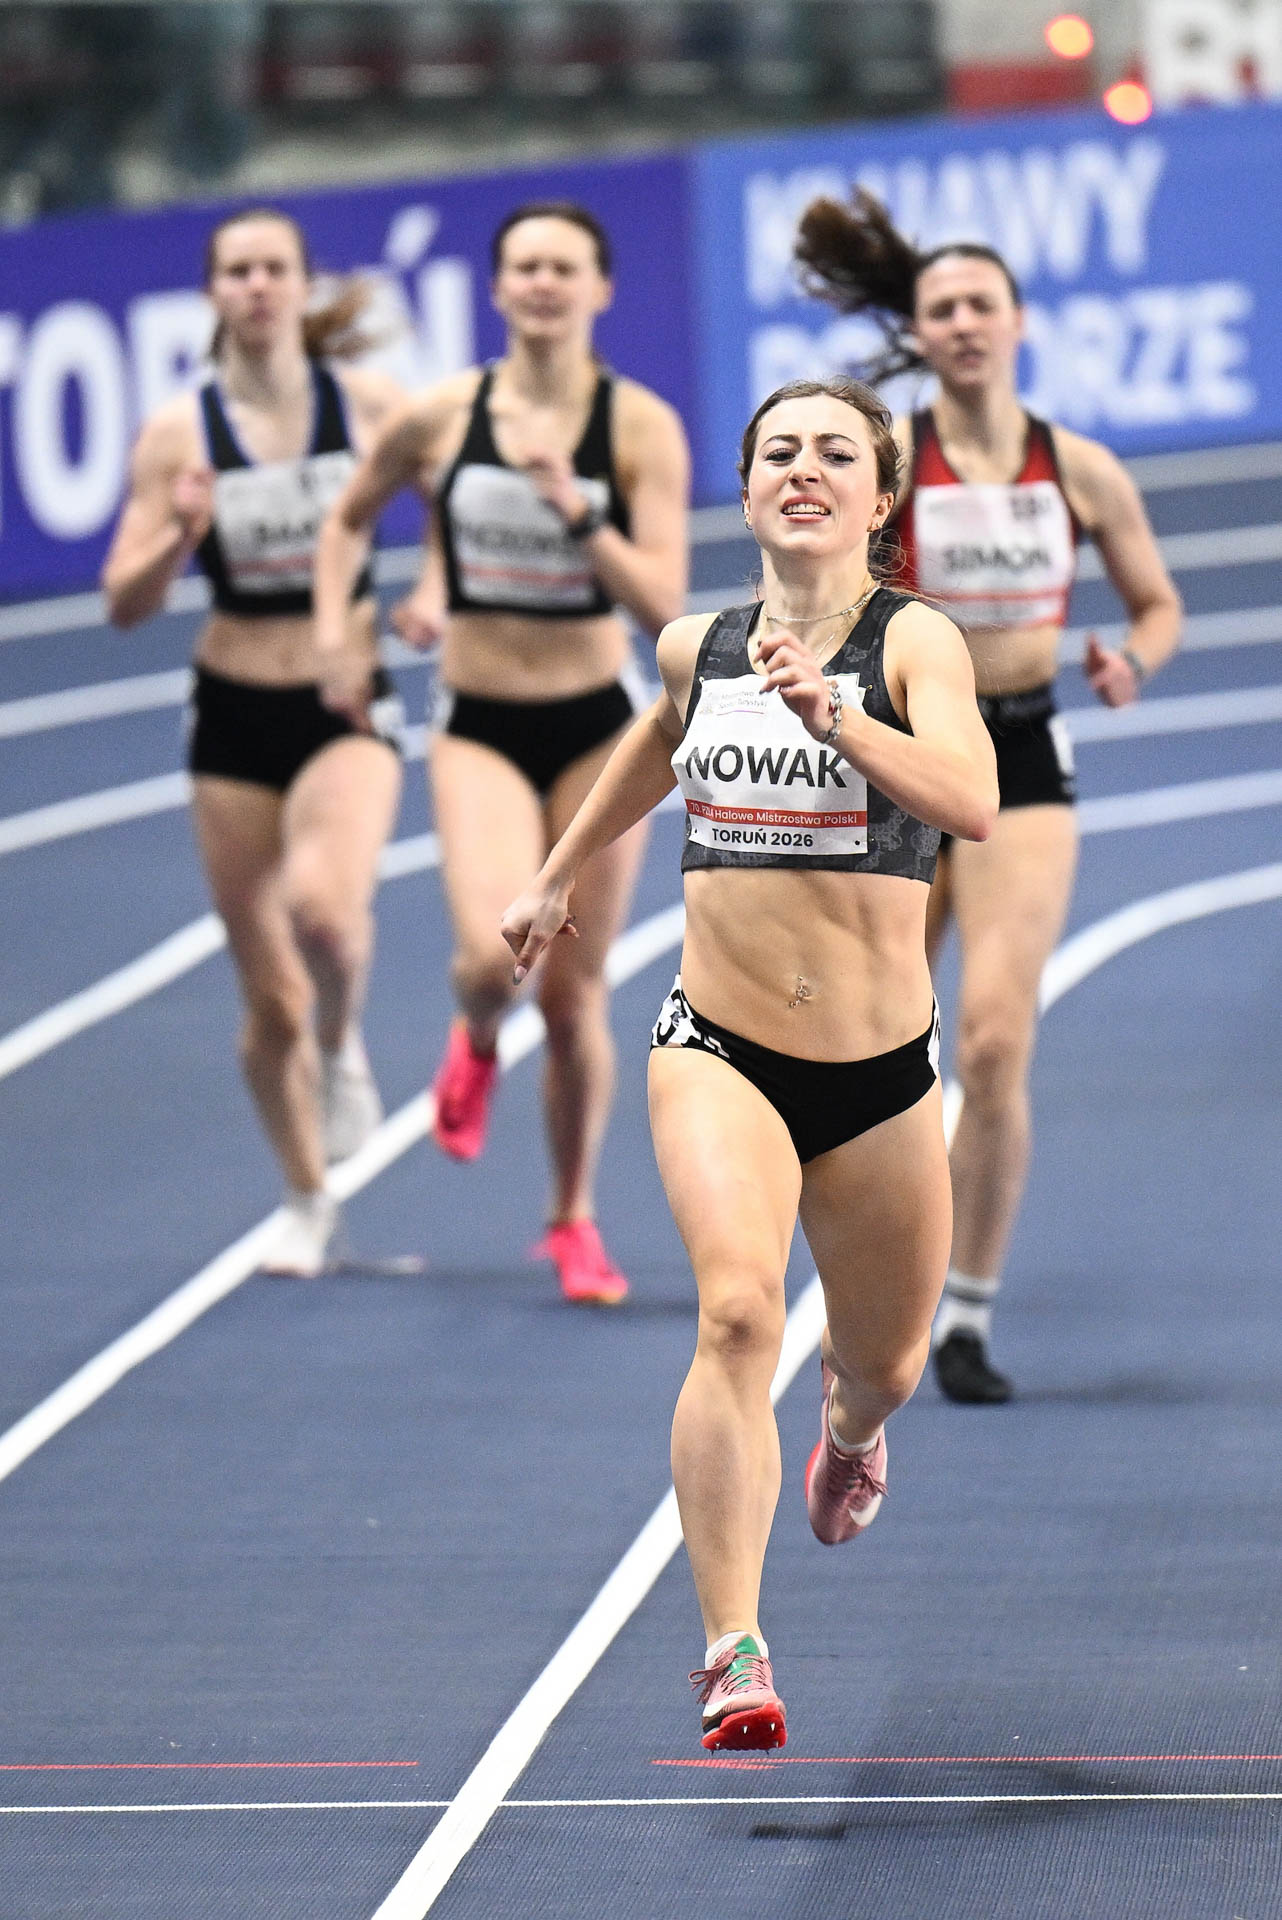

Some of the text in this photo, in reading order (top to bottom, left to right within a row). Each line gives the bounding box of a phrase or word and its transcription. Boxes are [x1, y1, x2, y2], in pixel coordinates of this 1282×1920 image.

[748, 283, 1256, 420] POORZE
[685, 743, 848, 788] NOWAK
[714, 809, 754, 821] Halowe
[756, 811, 821, 825] Mistrzostwa
[824, 813, 858, 825] Polski
[711, 827, 814, 848] TORUŃ 2026
